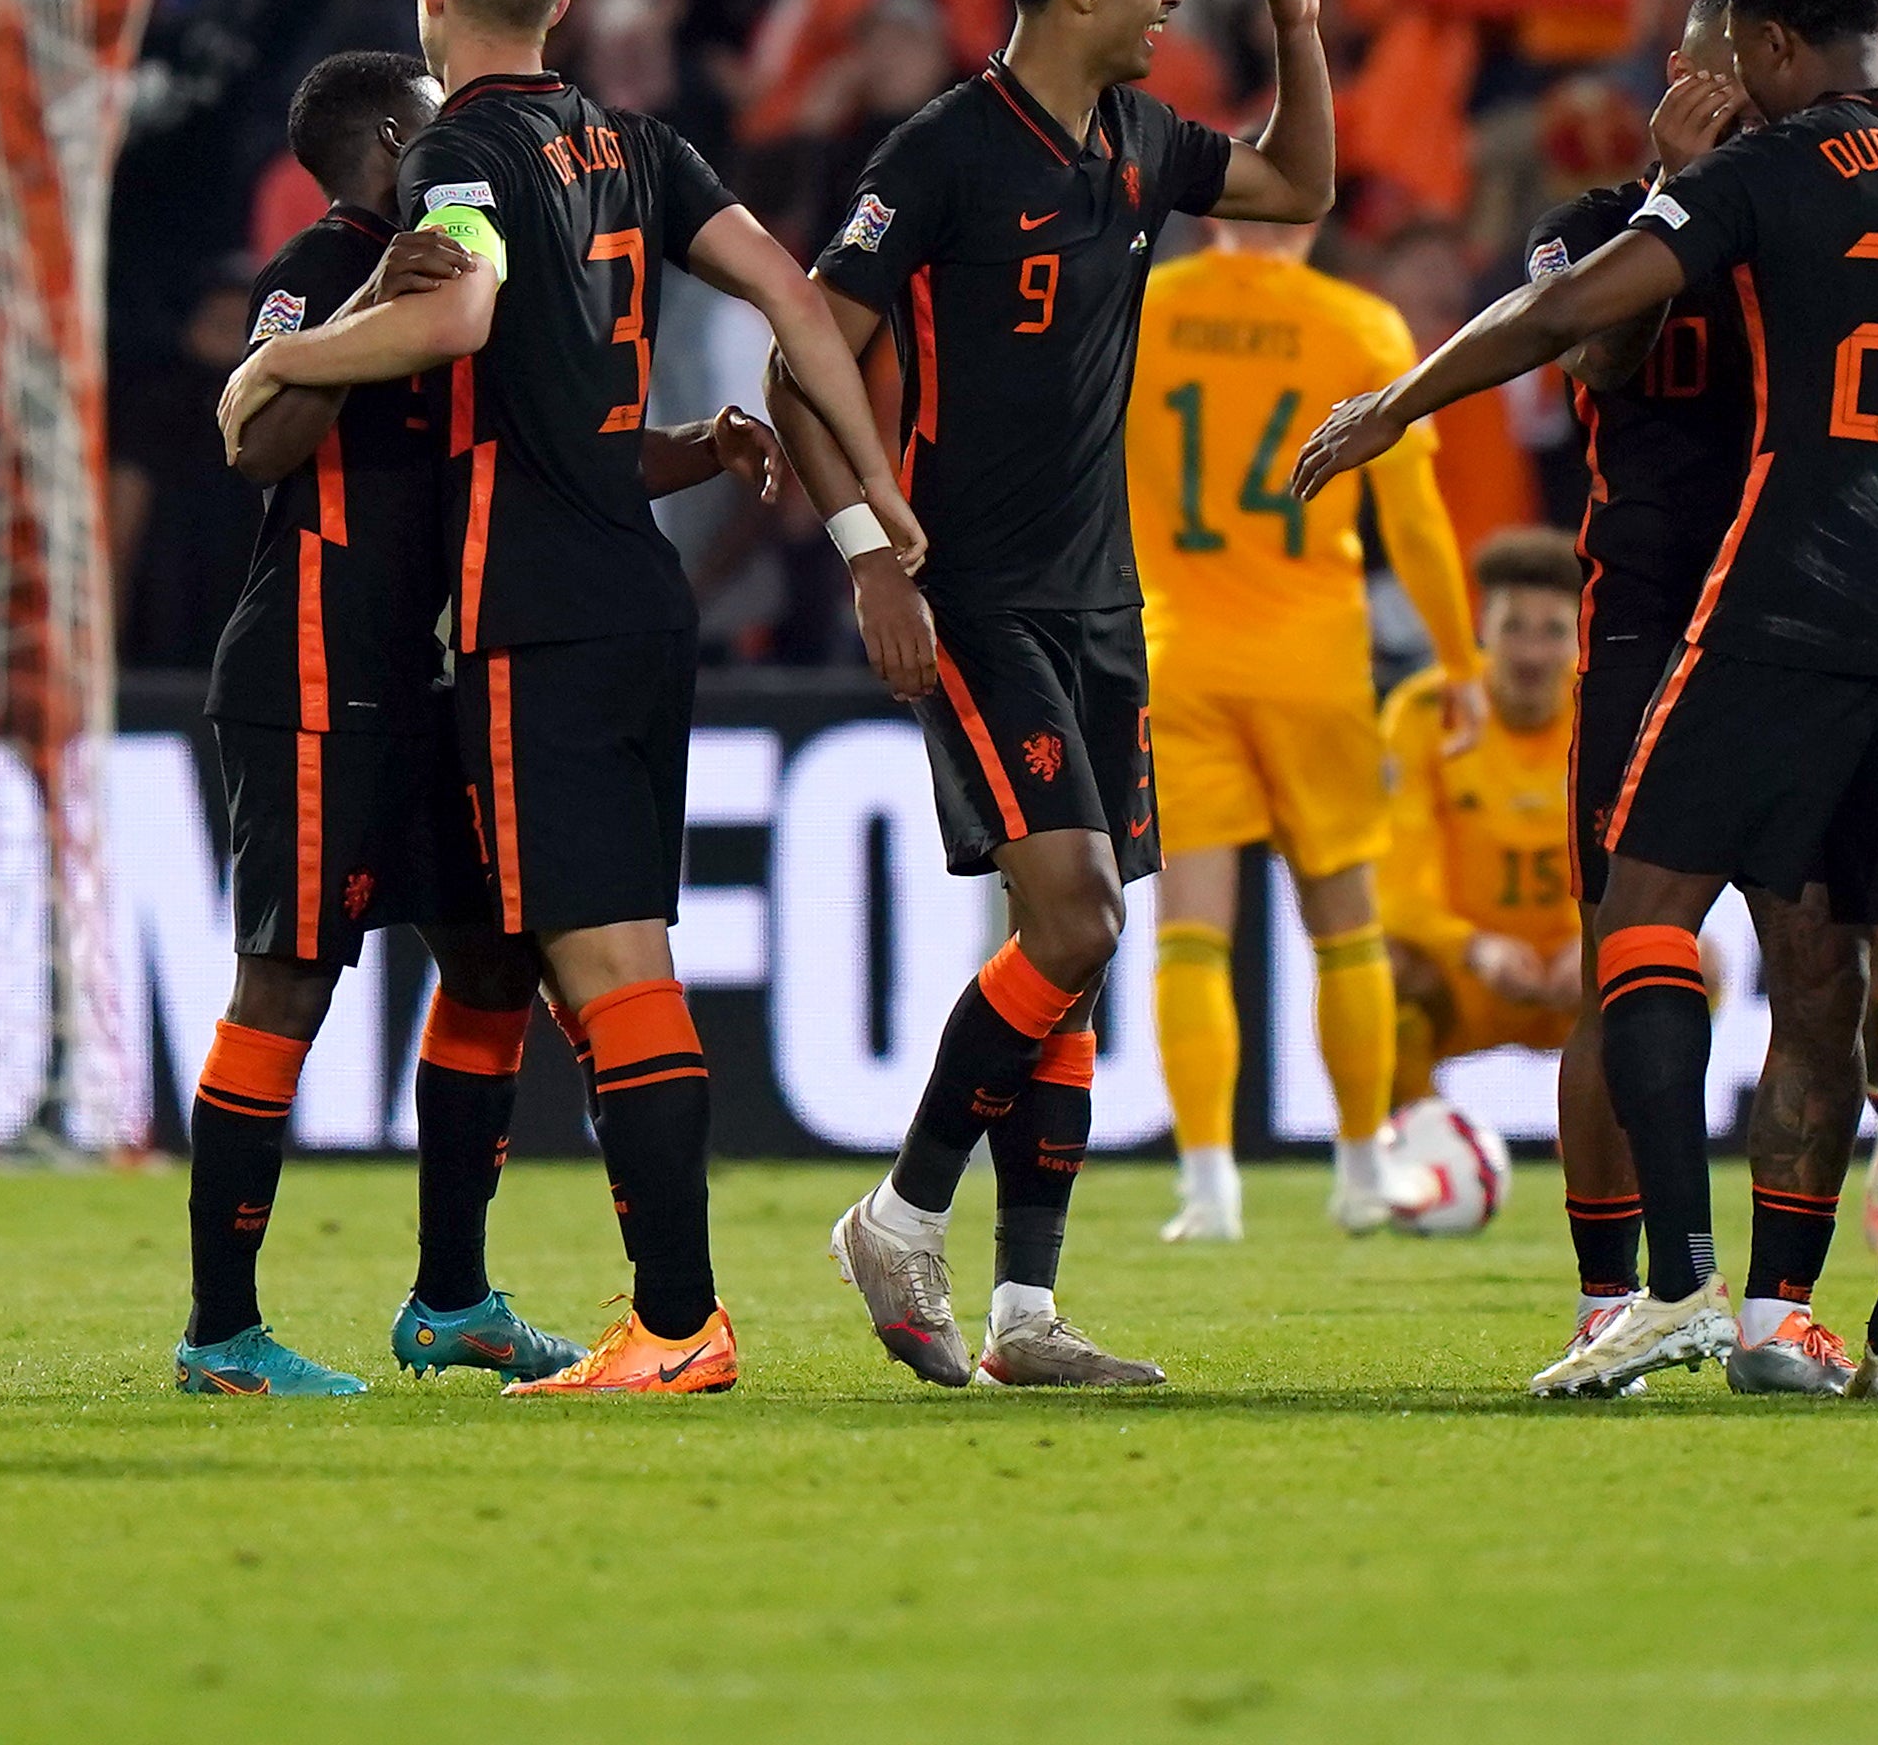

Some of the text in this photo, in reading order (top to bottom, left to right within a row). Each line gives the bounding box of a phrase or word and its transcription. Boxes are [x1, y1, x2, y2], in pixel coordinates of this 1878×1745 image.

[542, 136, 577, 186] DE
[587, 227, 651, 434] 3
[1013, 254, 1060, 334] 9
[1165, 380, 1307, 559] 14
[1498, 846, 1566, 909] 15
